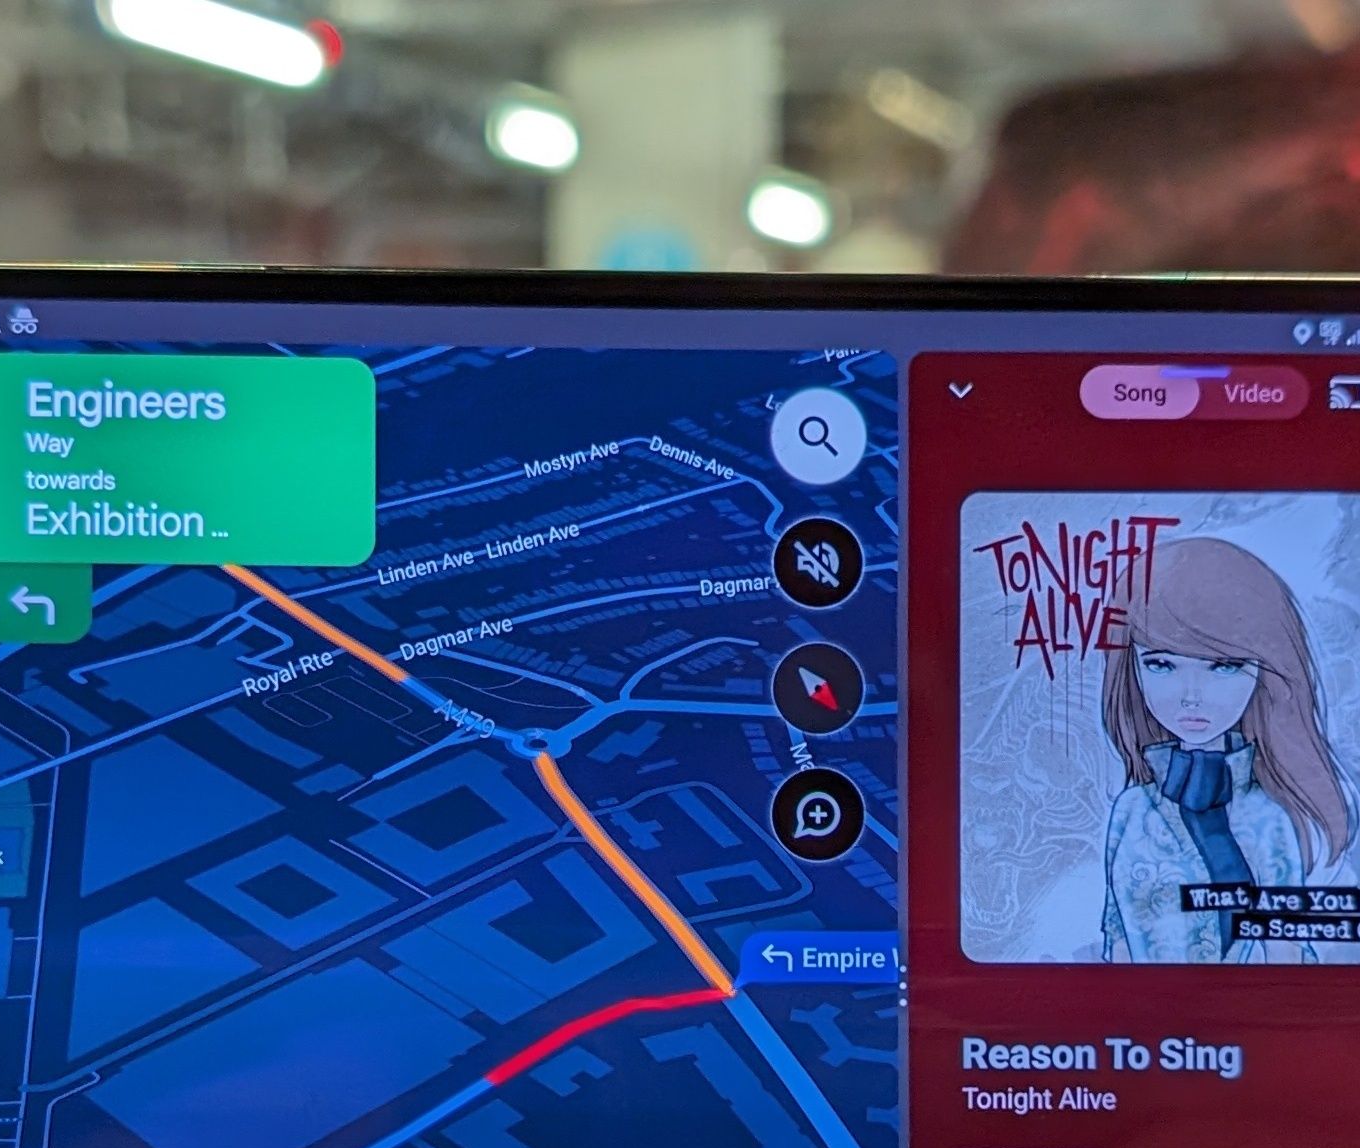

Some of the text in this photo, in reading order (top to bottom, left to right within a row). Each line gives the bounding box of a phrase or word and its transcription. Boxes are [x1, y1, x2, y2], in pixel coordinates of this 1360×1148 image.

[26, 380, 227, 428] Engineers
[1113, 382, 1285, 408] Song Video
[26, 432, 74, 458] Way
[524, 439, 620, 480] Mostyn Ave
[648, 434, 735, 481] Dennis Ave
[26, 470, 116, 492] towards
[26, 503, 205, 538] Exhibition
[485, 521, 580, 561] Linden Ave
[377, 548, 475, 587] Linden Ave
[700, 576, 771, 598] Dagmar
[399, 615, 514, 663] Dagmar Ave
[242, 650, 335, 698] Royal Rte
[433, 698, 496, 739] A479
[1188, 886, 1356, 911] What Are You
[1239, 920, 1264, 938] So
[1268, 918, 1353, 939] Scared
[802, 946, 886, 974] Empire
[961, 1037, 1242, 1079] Reason To Sing
[961, 1086, 1117, 1115] Tonight Alive
